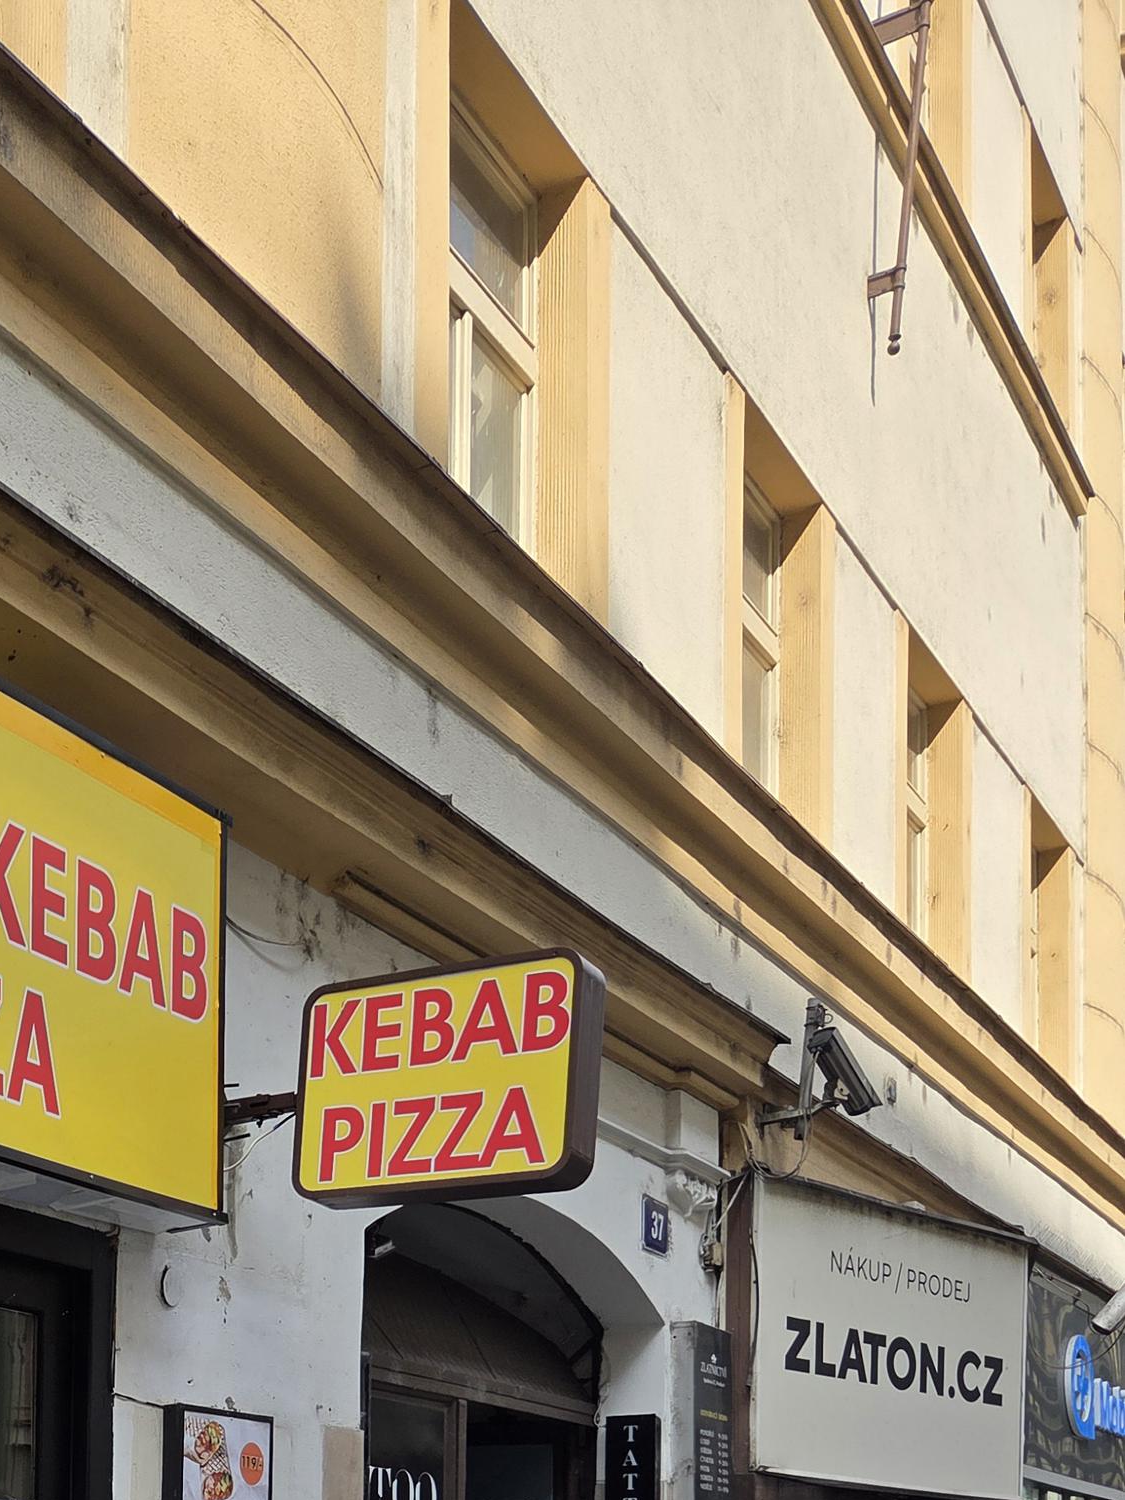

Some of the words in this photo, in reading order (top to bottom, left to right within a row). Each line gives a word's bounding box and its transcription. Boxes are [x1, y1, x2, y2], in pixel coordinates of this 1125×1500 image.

[309, 971, 571, 1080] KEBAB
[318, 1086, 546, 1184] PIZZA
[650, 1214, 664, 1241] 37
[830, 1248, 892, 1283] NÁKUP
[907, 1268, 971, 1303] PRODEJ
[784, 1315, 1003, 1407] ZLATON.CZ
